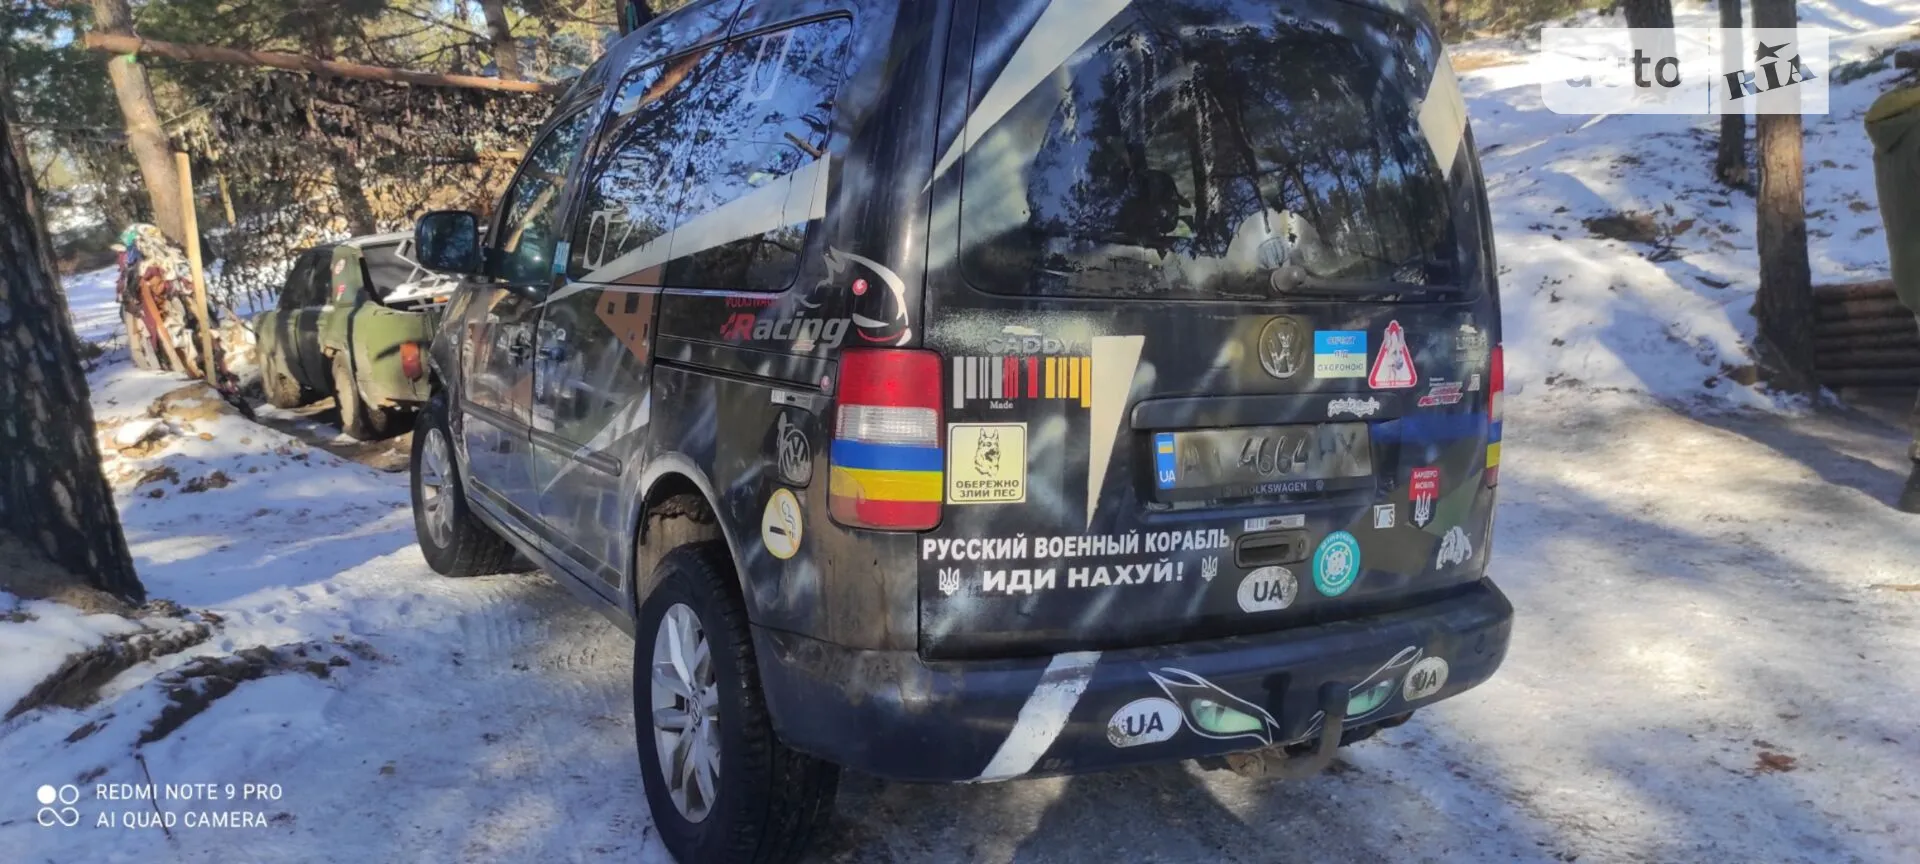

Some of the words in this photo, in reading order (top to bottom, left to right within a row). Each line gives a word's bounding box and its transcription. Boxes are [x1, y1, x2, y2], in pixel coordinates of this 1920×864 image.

[725, 311, 852, 349] Racing
[985, 336, 1073, 353] CADDY
[989, 401, 1013, 409] Made
[956, 479, 1020, 489] ОБЕРЕЖНО
[1159, 470, 1176, 483] UA
[960, 488, 990, 498] ЗЛИЙ
[994, 489, 1016, 498] ПЕС
[922, 533, 1028, 561] РУССКИЙ
[1034, 529, 1139, 559] ВОЕННЫЙ
[982, 567, 1057, 595] ИДИ
[1067, 558, 1184, 588] НАХУЙ!
[1253, 581, 1285, 602] UA
[1126, 711, 1165, 736] UA
